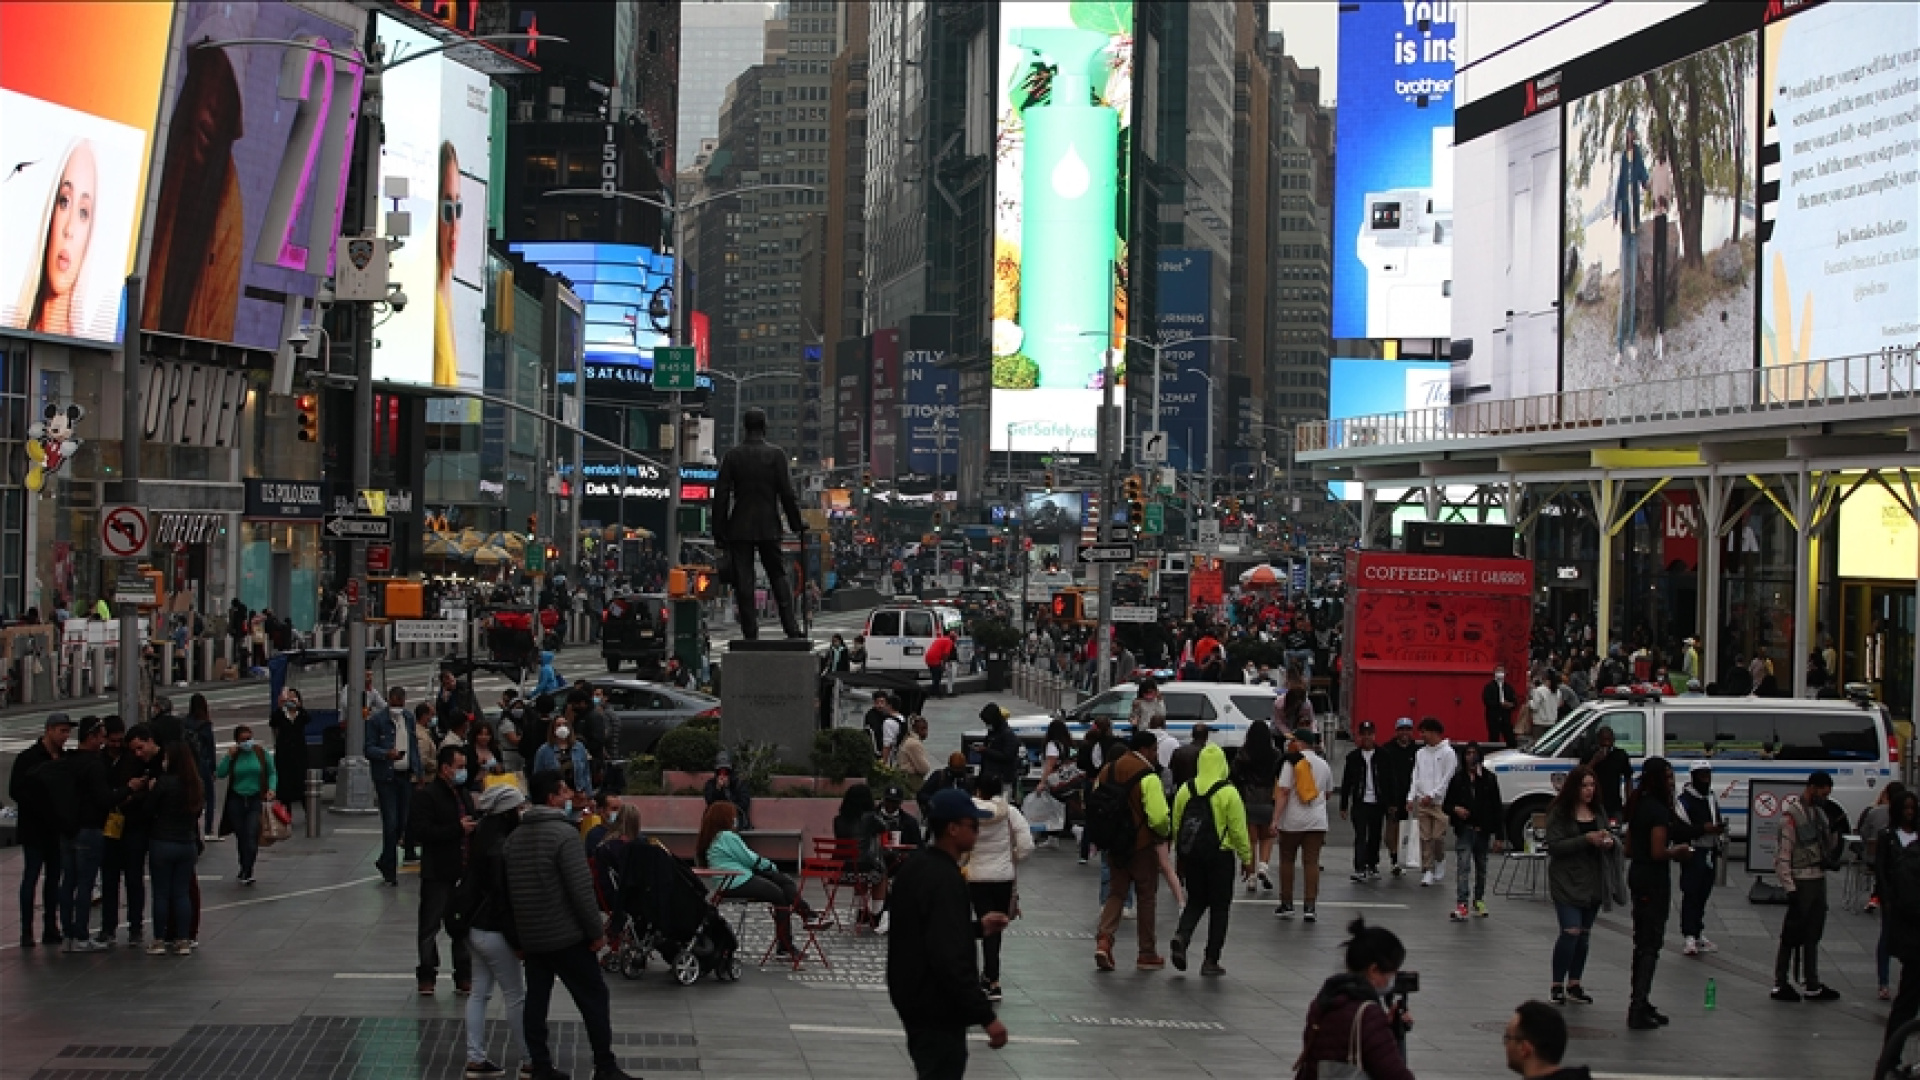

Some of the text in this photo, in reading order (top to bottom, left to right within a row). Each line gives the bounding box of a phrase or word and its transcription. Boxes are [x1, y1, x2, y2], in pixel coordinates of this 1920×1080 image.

[1395, 32, 1417, 65] is
[1395, 78, 1454, 94] brother
[603, 124, 616, 198] 1500
